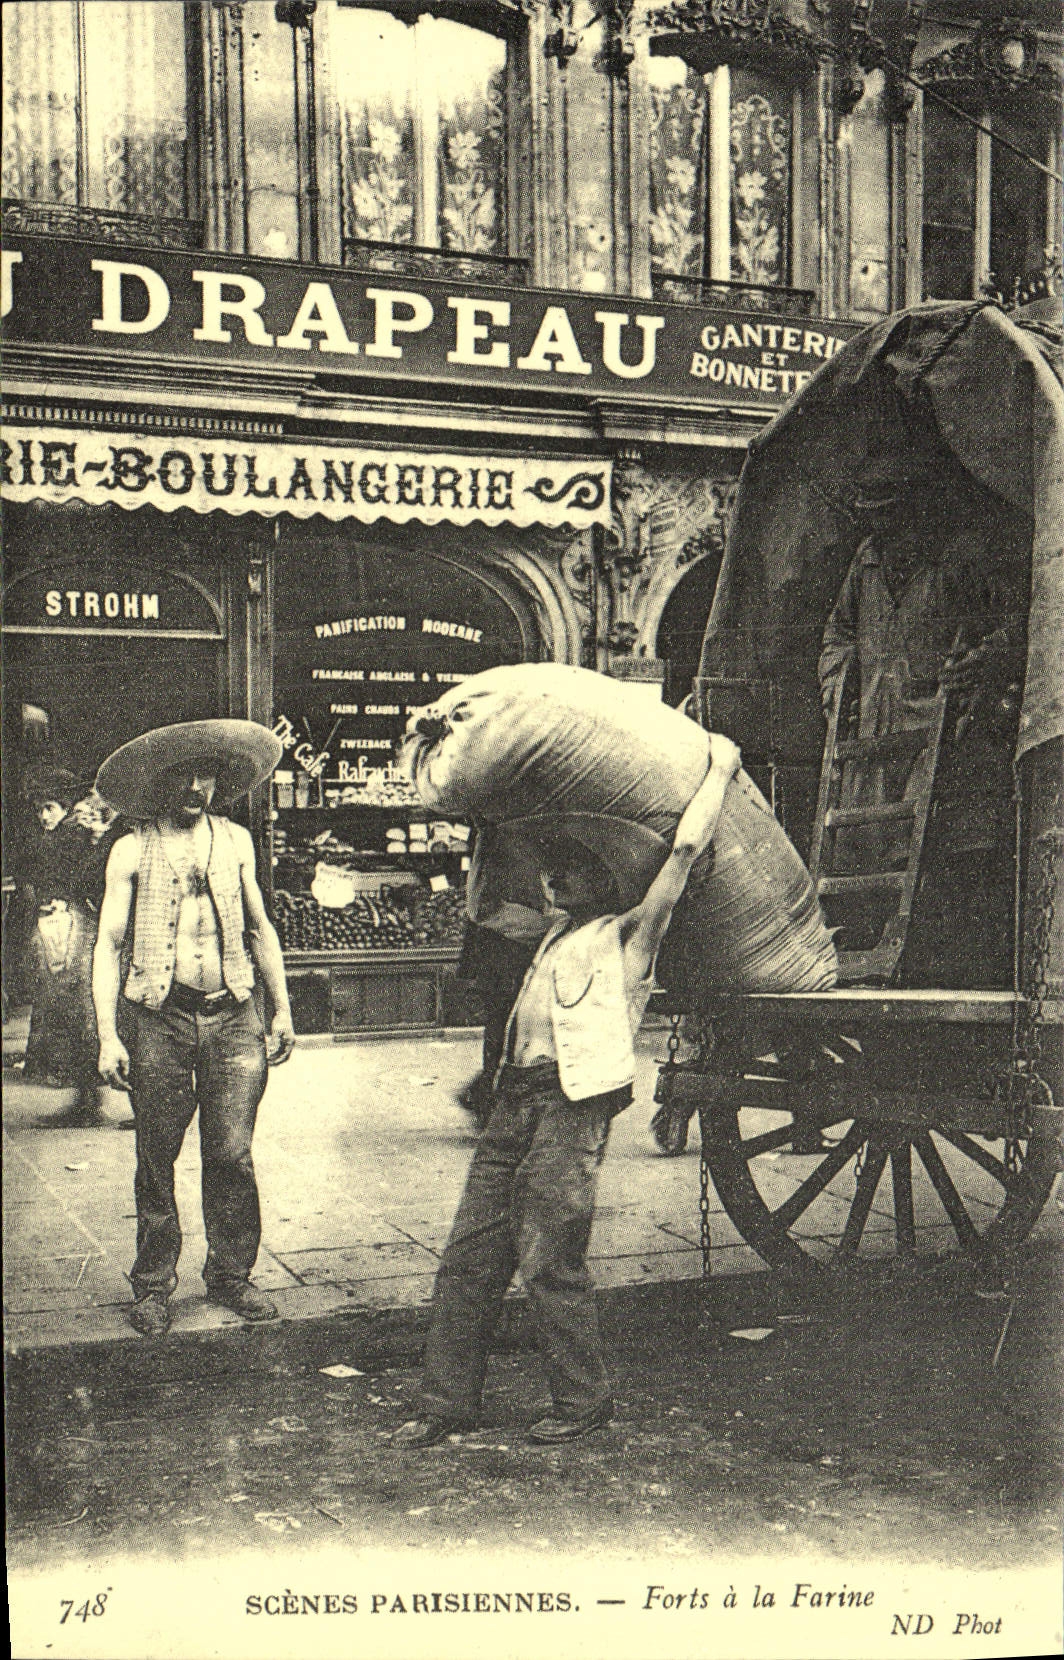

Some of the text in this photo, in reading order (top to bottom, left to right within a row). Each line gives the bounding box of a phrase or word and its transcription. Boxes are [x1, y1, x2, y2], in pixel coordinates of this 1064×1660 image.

[91, 259, 665, 379] DRAPEAU
[761, 352, 789, 367] ET
[45, 590, 159, 619] STROHM
[314, 615, 406, 639] PANIFICATION
[293, 743, 331, 778] Café
